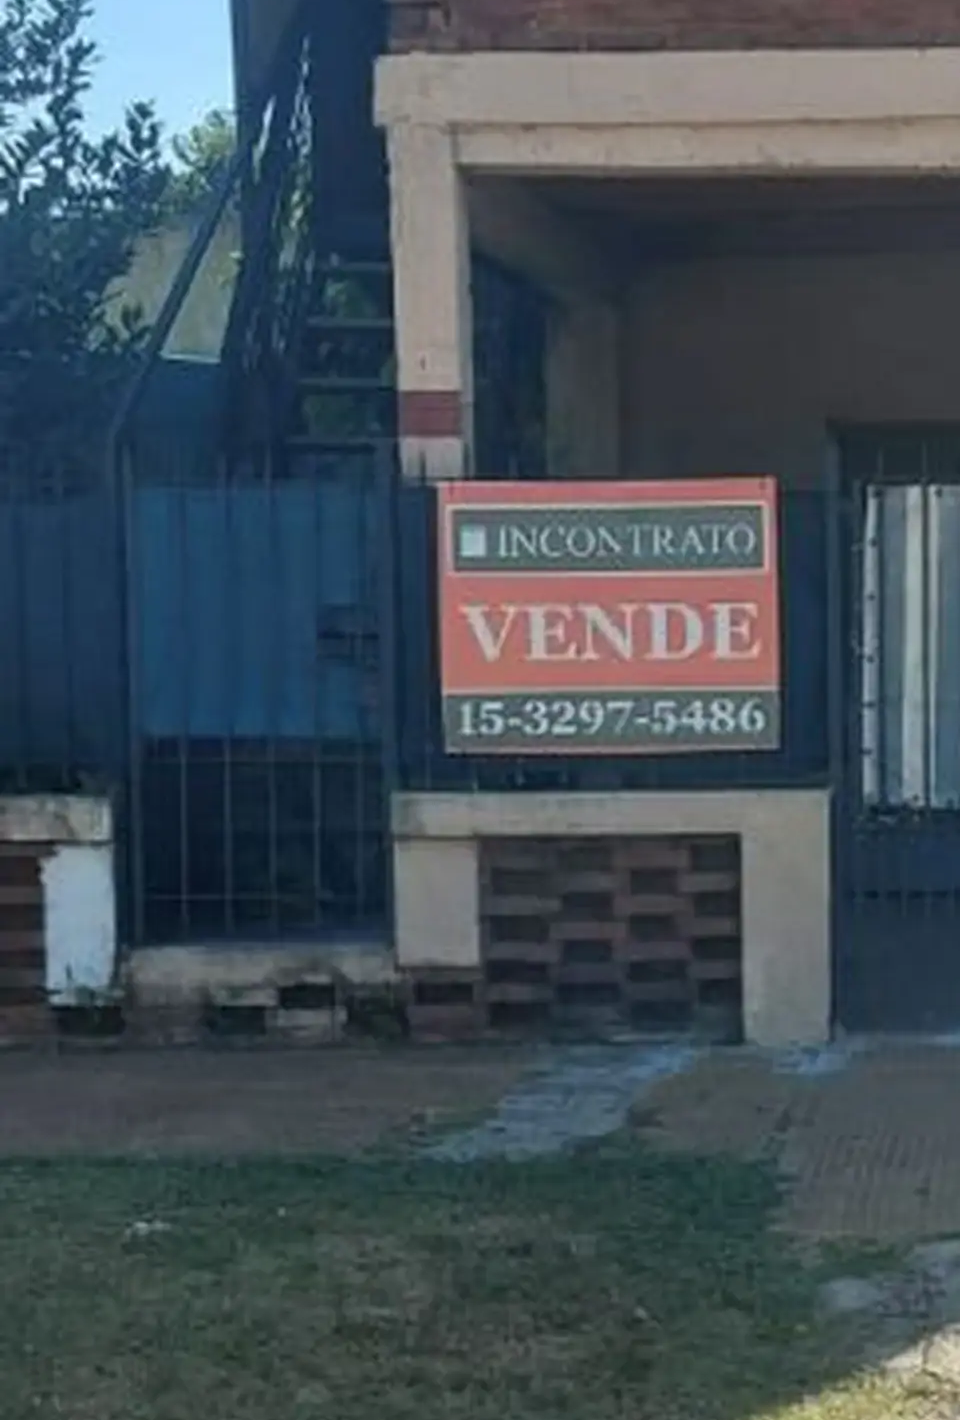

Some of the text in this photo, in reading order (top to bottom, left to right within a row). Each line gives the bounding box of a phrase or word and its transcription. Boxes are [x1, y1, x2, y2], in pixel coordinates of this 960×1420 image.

[499, 522, 756, 558] INCONTRATO
[459, 601, 762, 662] VENDE
[459, 698, 766, 736] 15-3297-5486
